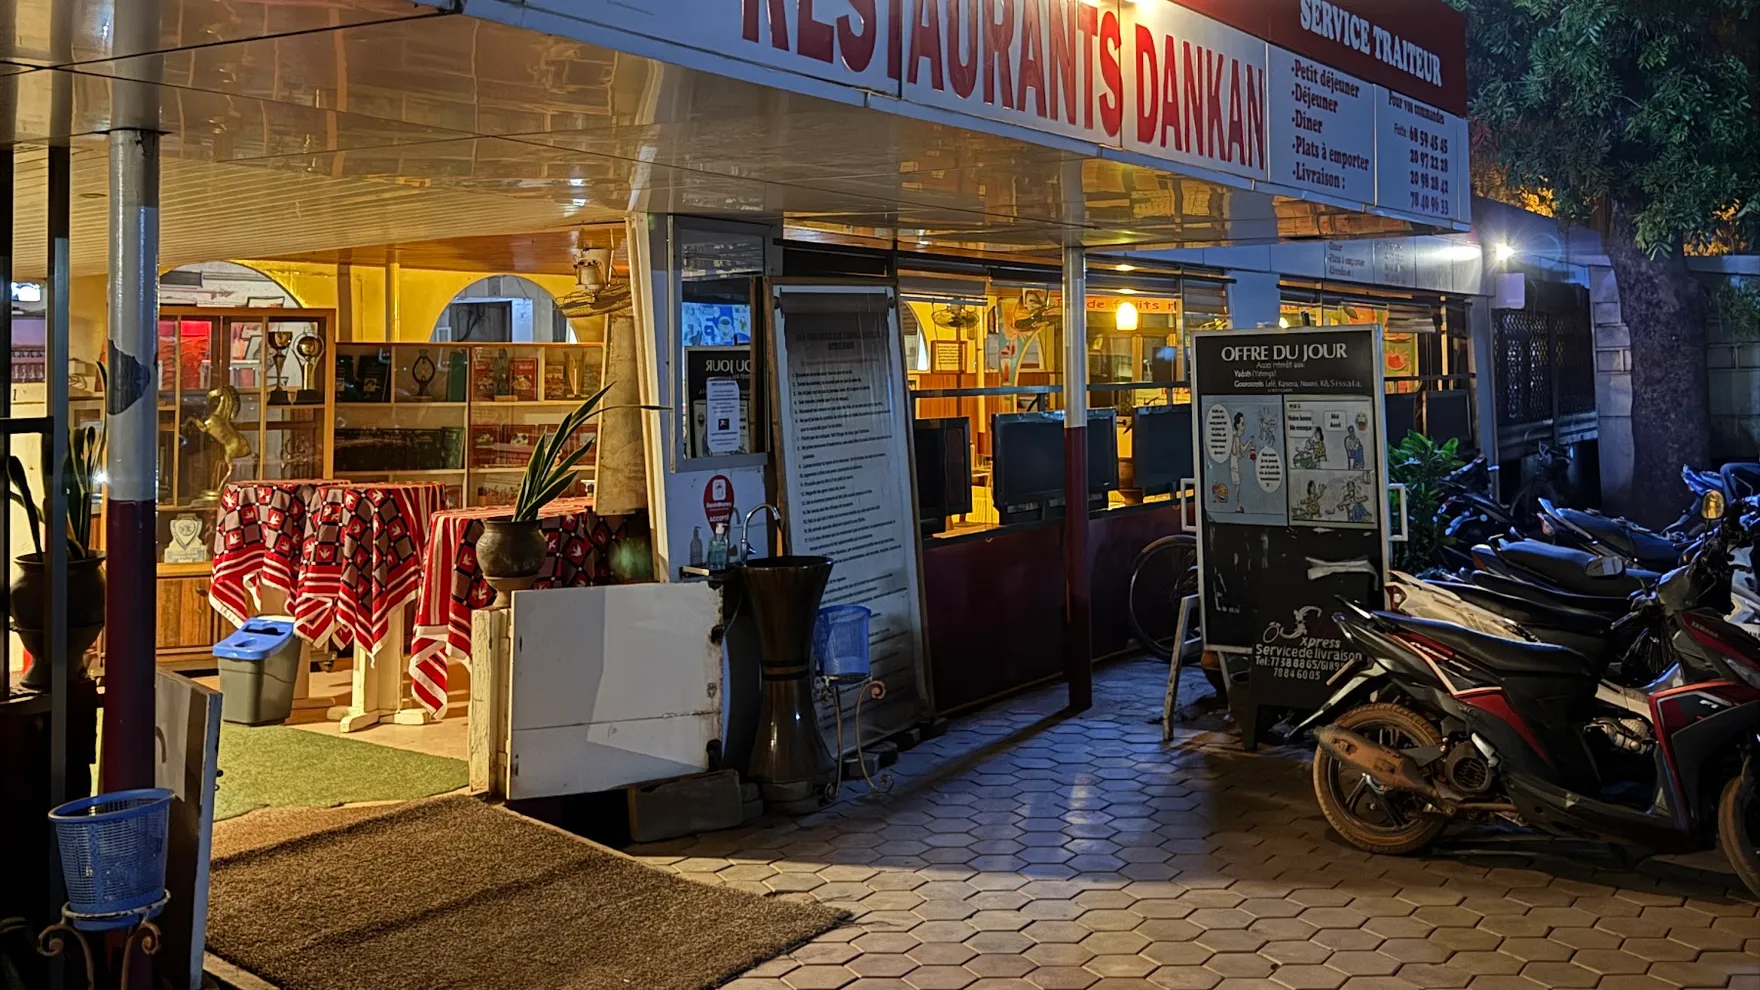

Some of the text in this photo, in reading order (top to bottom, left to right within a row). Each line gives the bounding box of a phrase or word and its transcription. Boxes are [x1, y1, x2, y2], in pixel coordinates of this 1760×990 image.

[1300, 0, 1442, 87] SERVICE TRAITEUR
[742, 0, 1264, 170] STAURANTS DANKAN
[1294, 59, 1360, 98] Petit déjeuner
[1295, 83, 1338, 113] Déjeuner
[1295, 135, 1370, 172] Plats à emporter
[1087, 300, 1105, 309] de
[1113, 300, 1160, 310] fuits
[1221, 343, 1347, 362] OFFRE DU JOUR
[1255, 643, 1362, 661] Service de livraison
